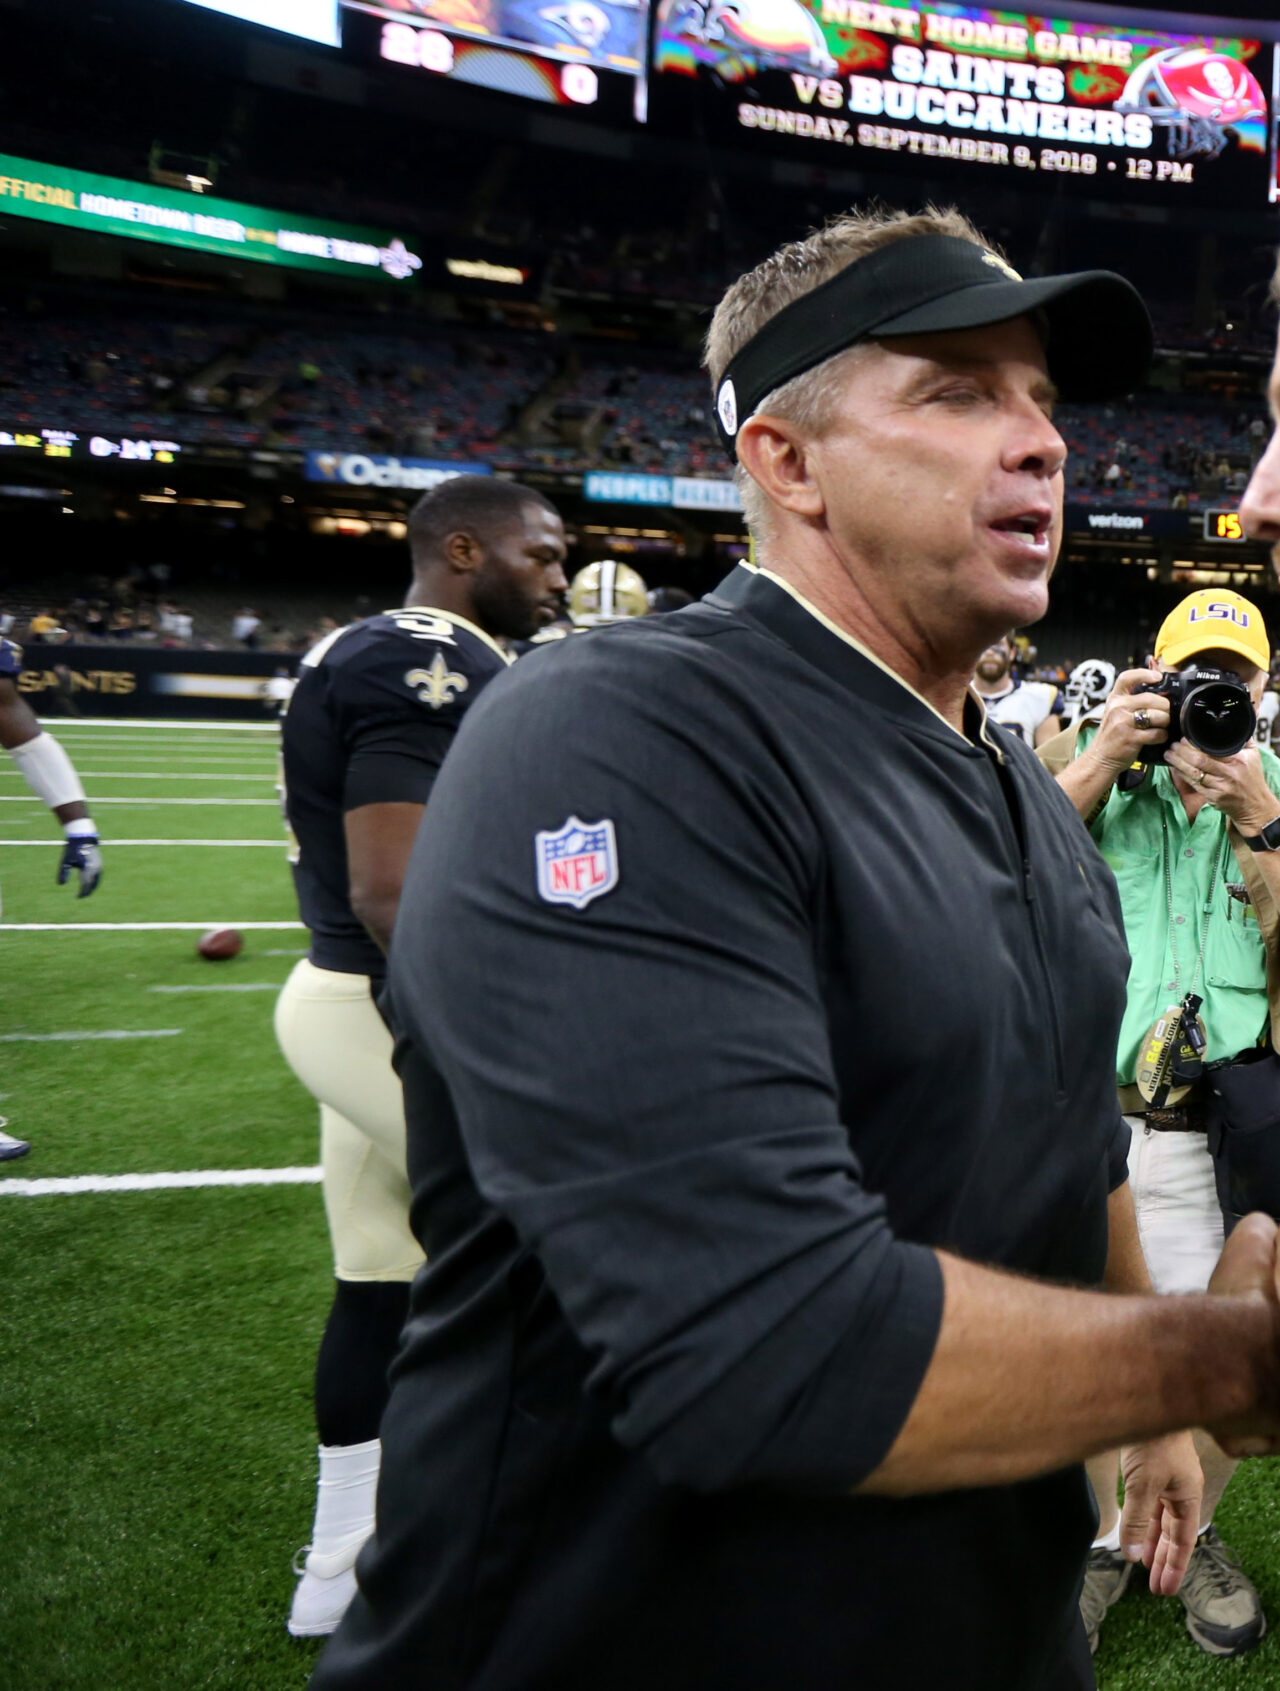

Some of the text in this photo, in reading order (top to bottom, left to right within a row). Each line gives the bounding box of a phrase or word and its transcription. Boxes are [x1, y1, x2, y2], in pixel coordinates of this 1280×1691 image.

[820, 0, 1133, 67] NEXT HOME GAME
[891, 44, 1065, 104] SAINTS
[791, 72, 1153, 149] VS BUCCANEERS
[738, 102, 1194, 183] SUNDAY, SEPTEMBER 9, 2018 12 PM
[1088, 513, 1144, 530] verizon
[1189, 603, 1249, 629] LSU
[17, 669, 137, 695] SANTS
[1196, 671, 1221, 681] Nikon
[550, 854, 607, 892] NFL
[1148, 1016, 1181, 1093] PHOTOGRAPHER
